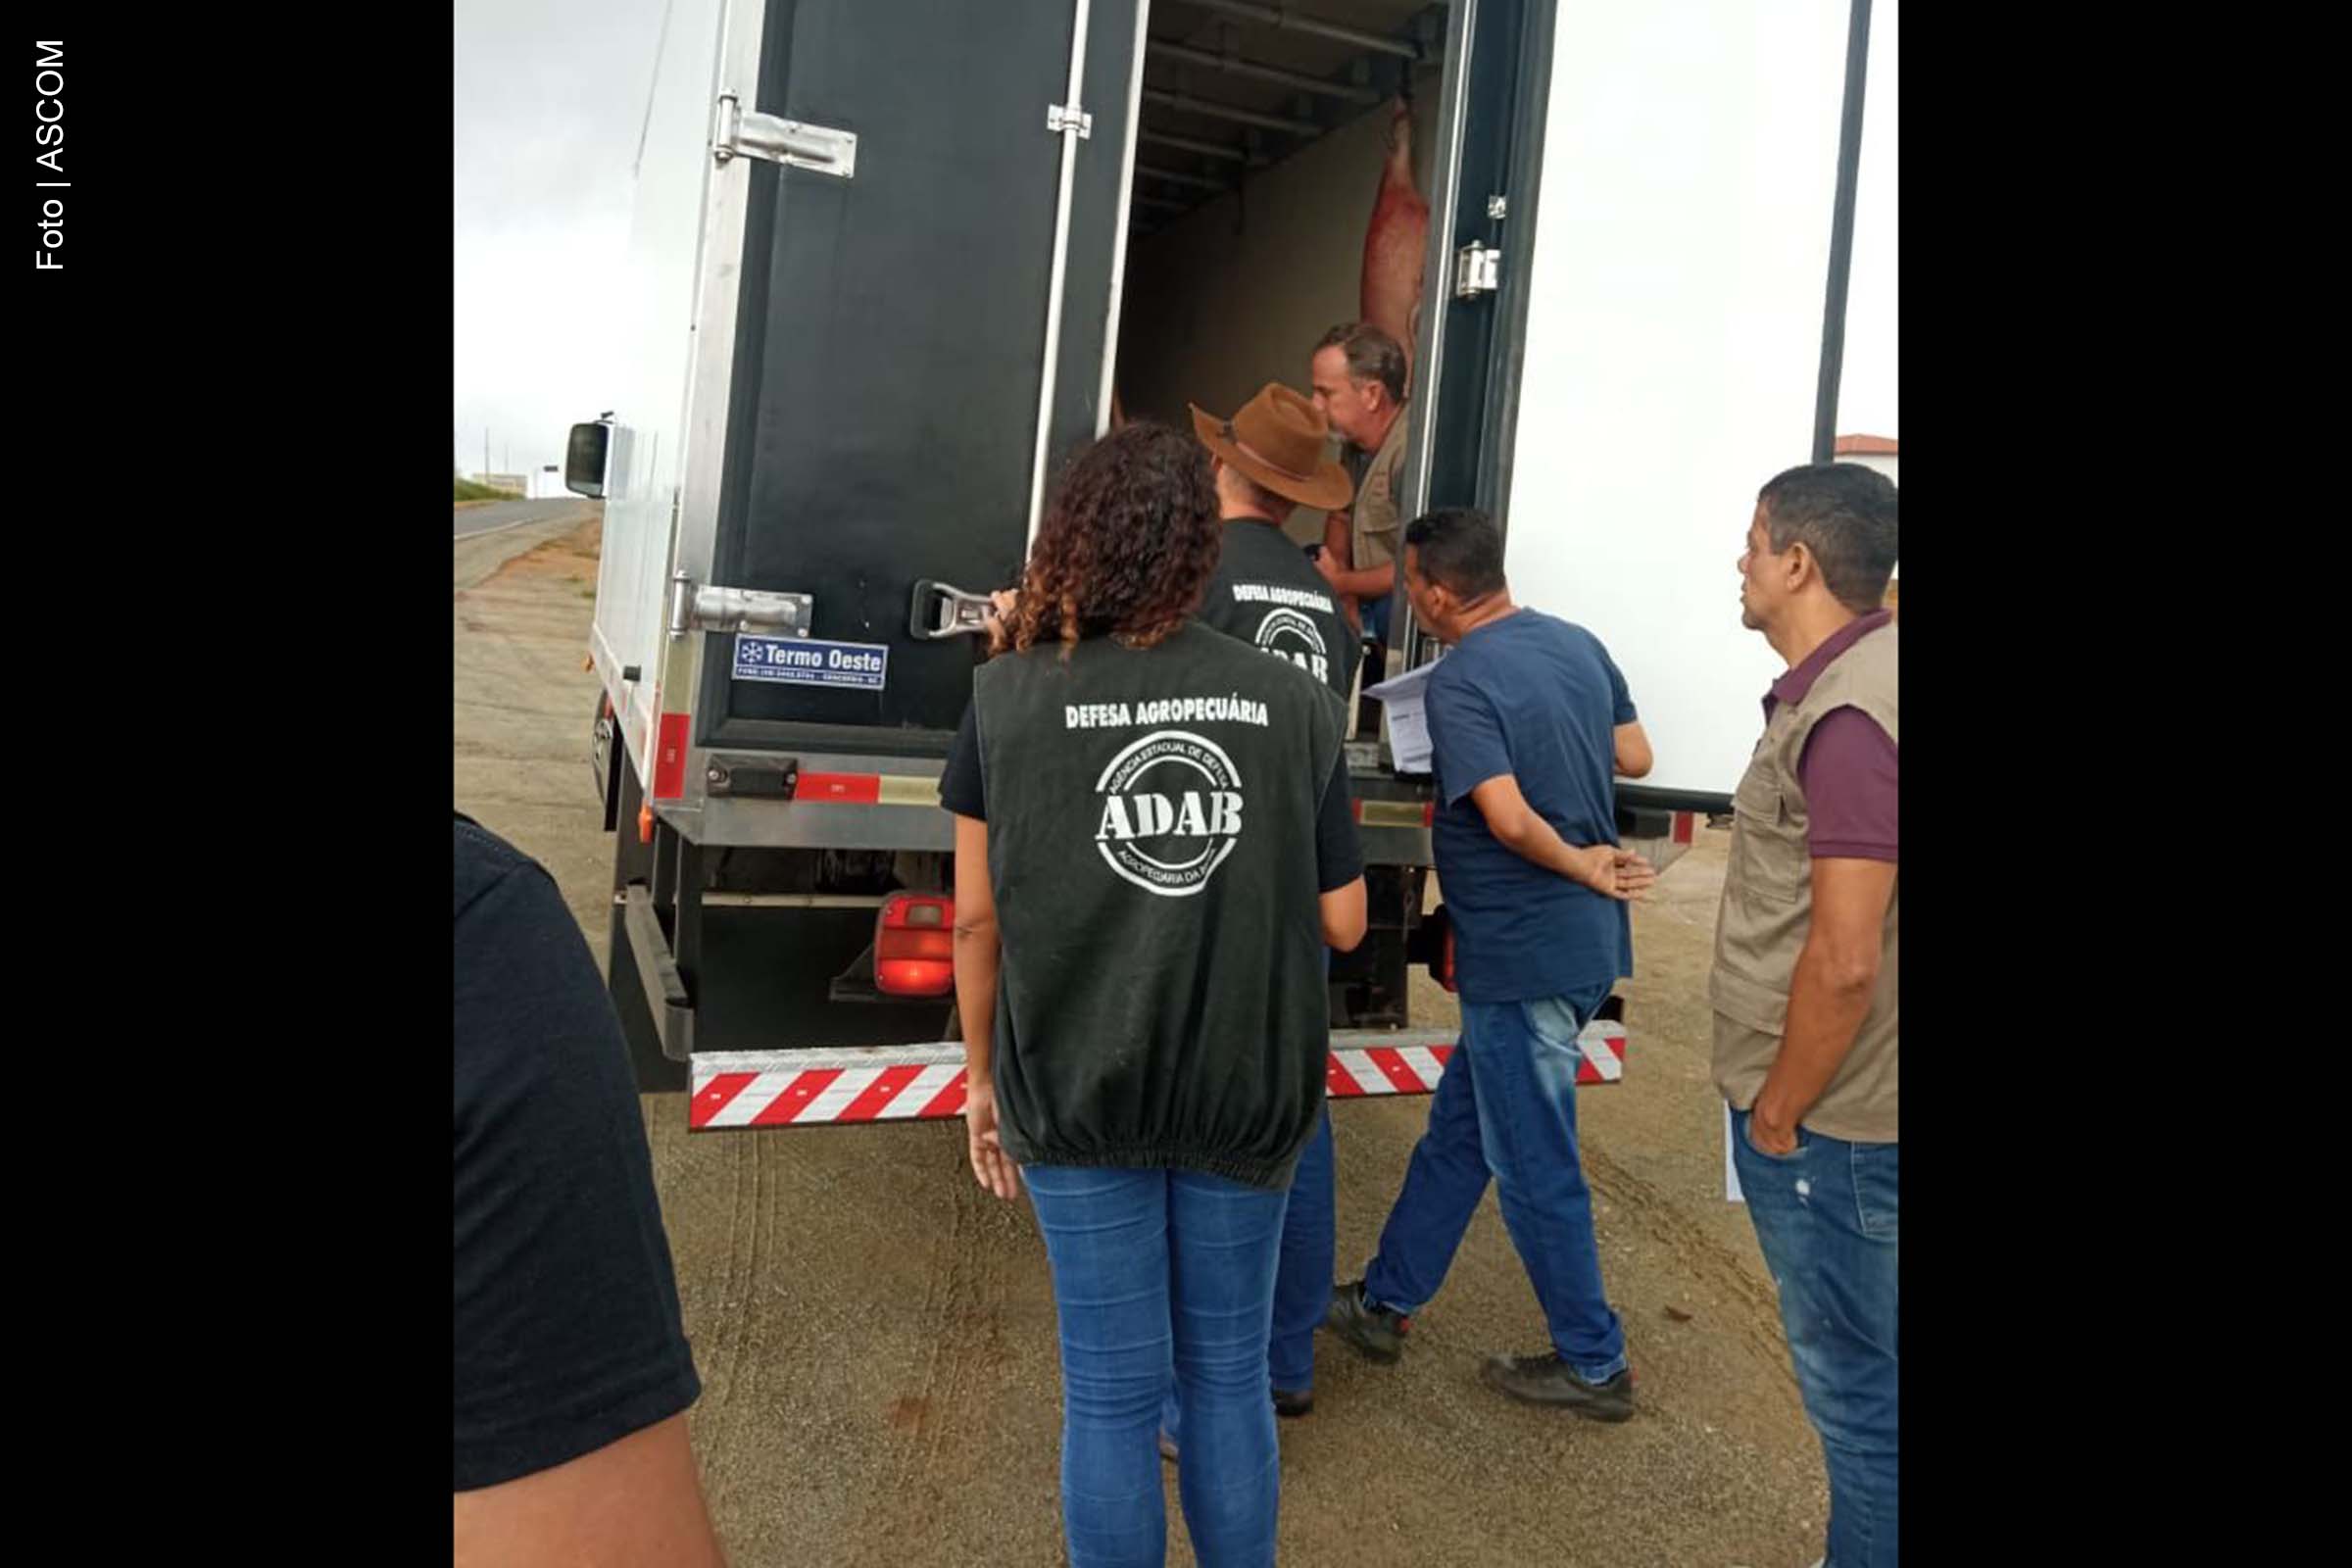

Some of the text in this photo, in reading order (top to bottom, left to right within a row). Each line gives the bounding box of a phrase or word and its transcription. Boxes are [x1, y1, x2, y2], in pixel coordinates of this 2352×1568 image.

[765, 644, 882, 671] Termo Oeste
[1065, 692, 1269, 728] DEFESA AGROPECUÁRIA
[1188, 745, 1203, 760] DE
[1202, 752, 1230, 789] DEFESA
[1095, 789, 1245, 840] ADAB
